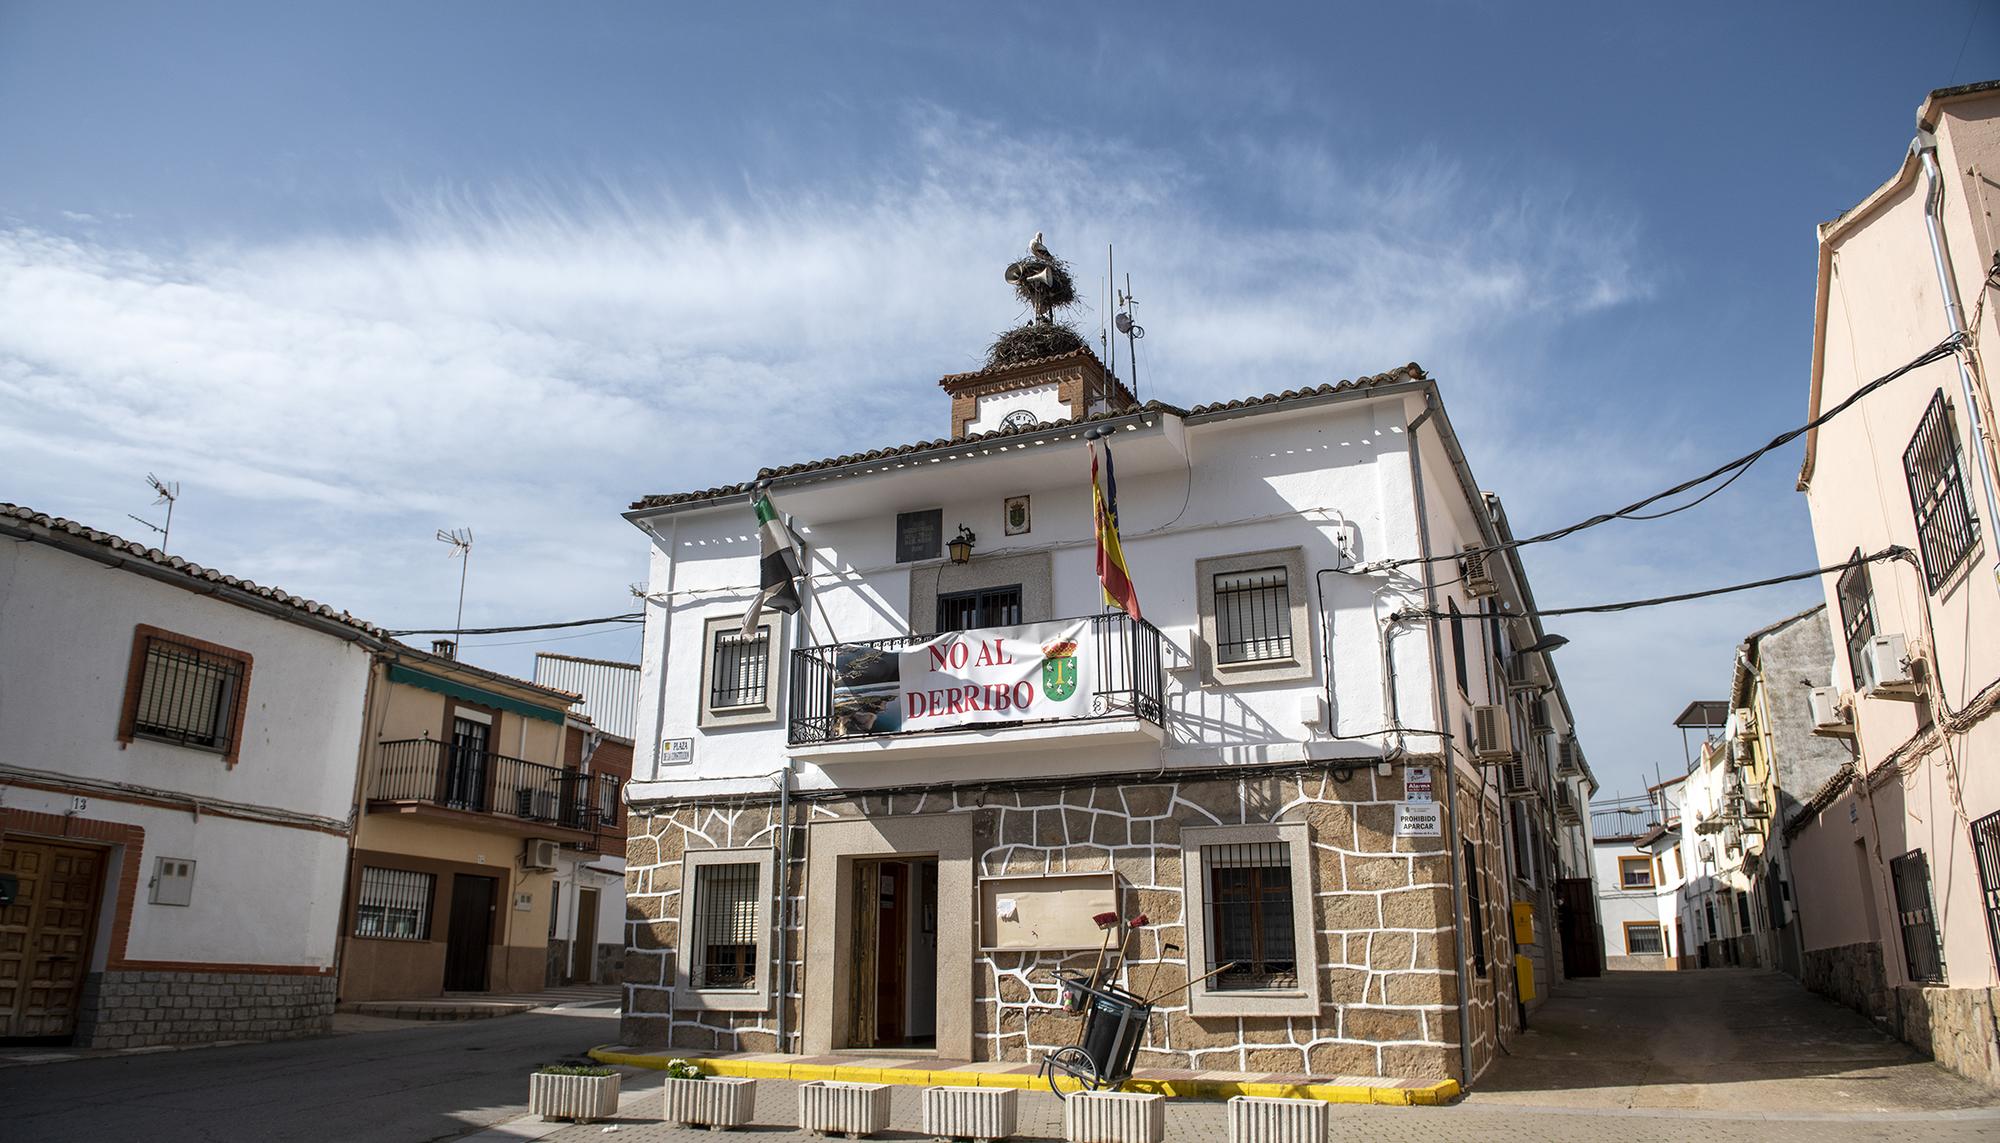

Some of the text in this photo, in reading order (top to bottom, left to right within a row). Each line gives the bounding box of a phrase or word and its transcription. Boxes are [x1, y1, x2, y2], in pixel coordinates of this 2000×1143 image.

[928, 638, 1013, 672] NO AL
[907, 680, 1034, 719] DERRIBO
[673, 742, 688, 750] PLAZA
[74, 798, 86, 810] 13
